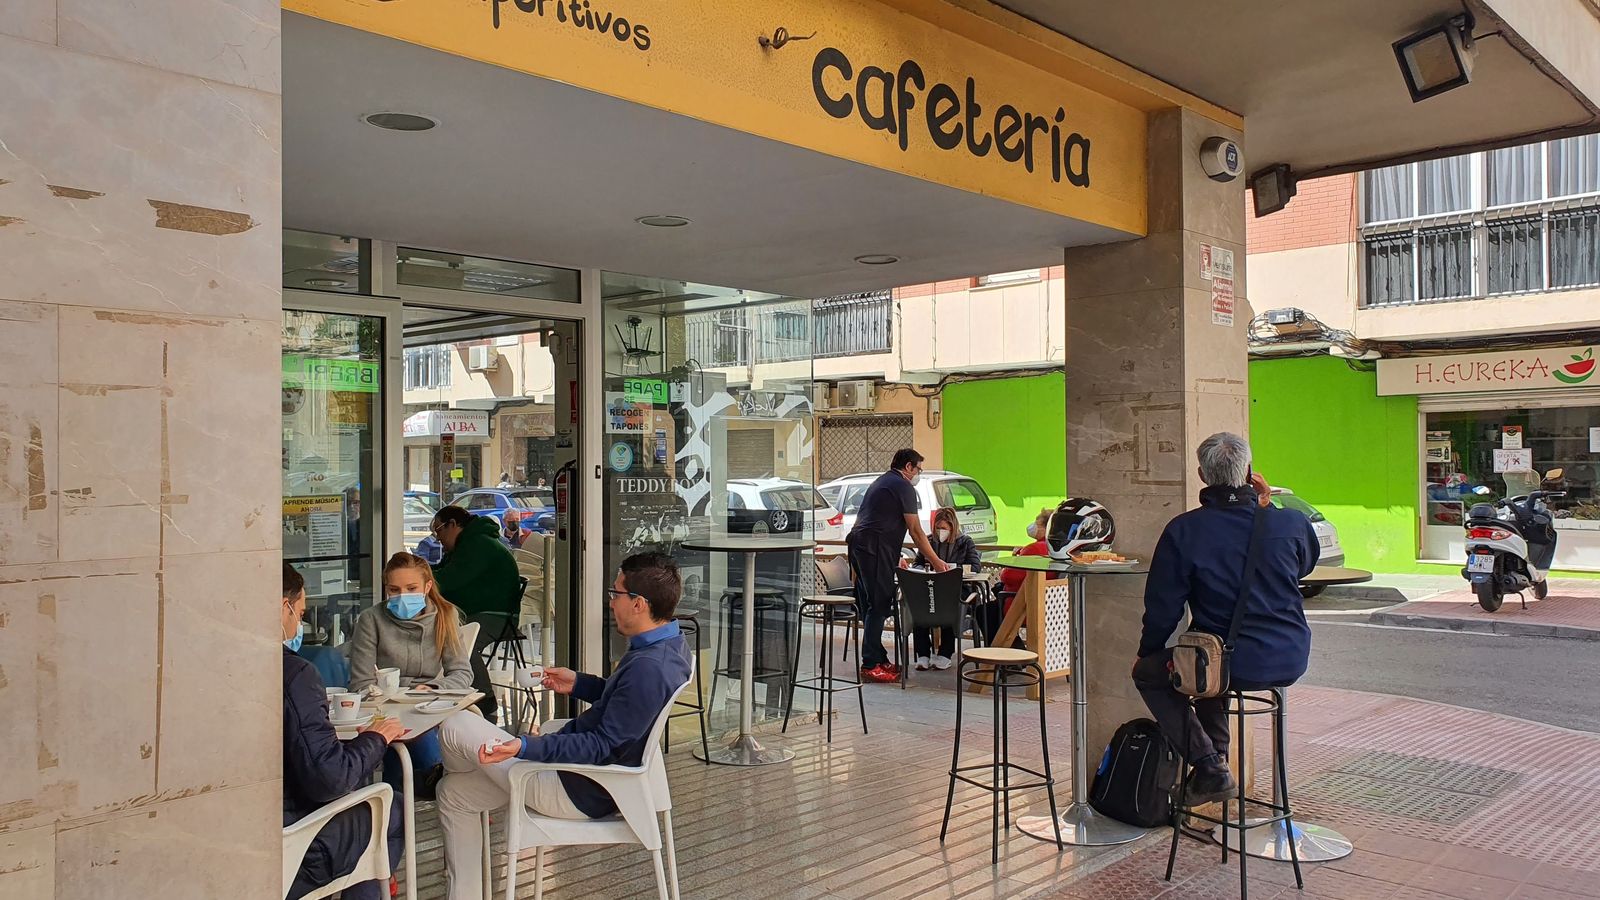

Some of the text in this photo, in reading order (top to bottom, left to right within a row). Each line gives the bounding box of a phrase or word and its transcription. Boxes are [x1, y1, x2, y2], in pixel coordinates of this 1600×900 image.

[483, 0, 651, 51] peritivos
[811, 47, 1091, 188] cafetería
[1415, 356, 1549, 385] H.EUREKA
[609, 408, 649, 417] RECOGEN
[443, 421, 477, 432] ALBA
[610, 422, 649, 431] TAPONES
[616, 478, 669, 493] TEDDY
